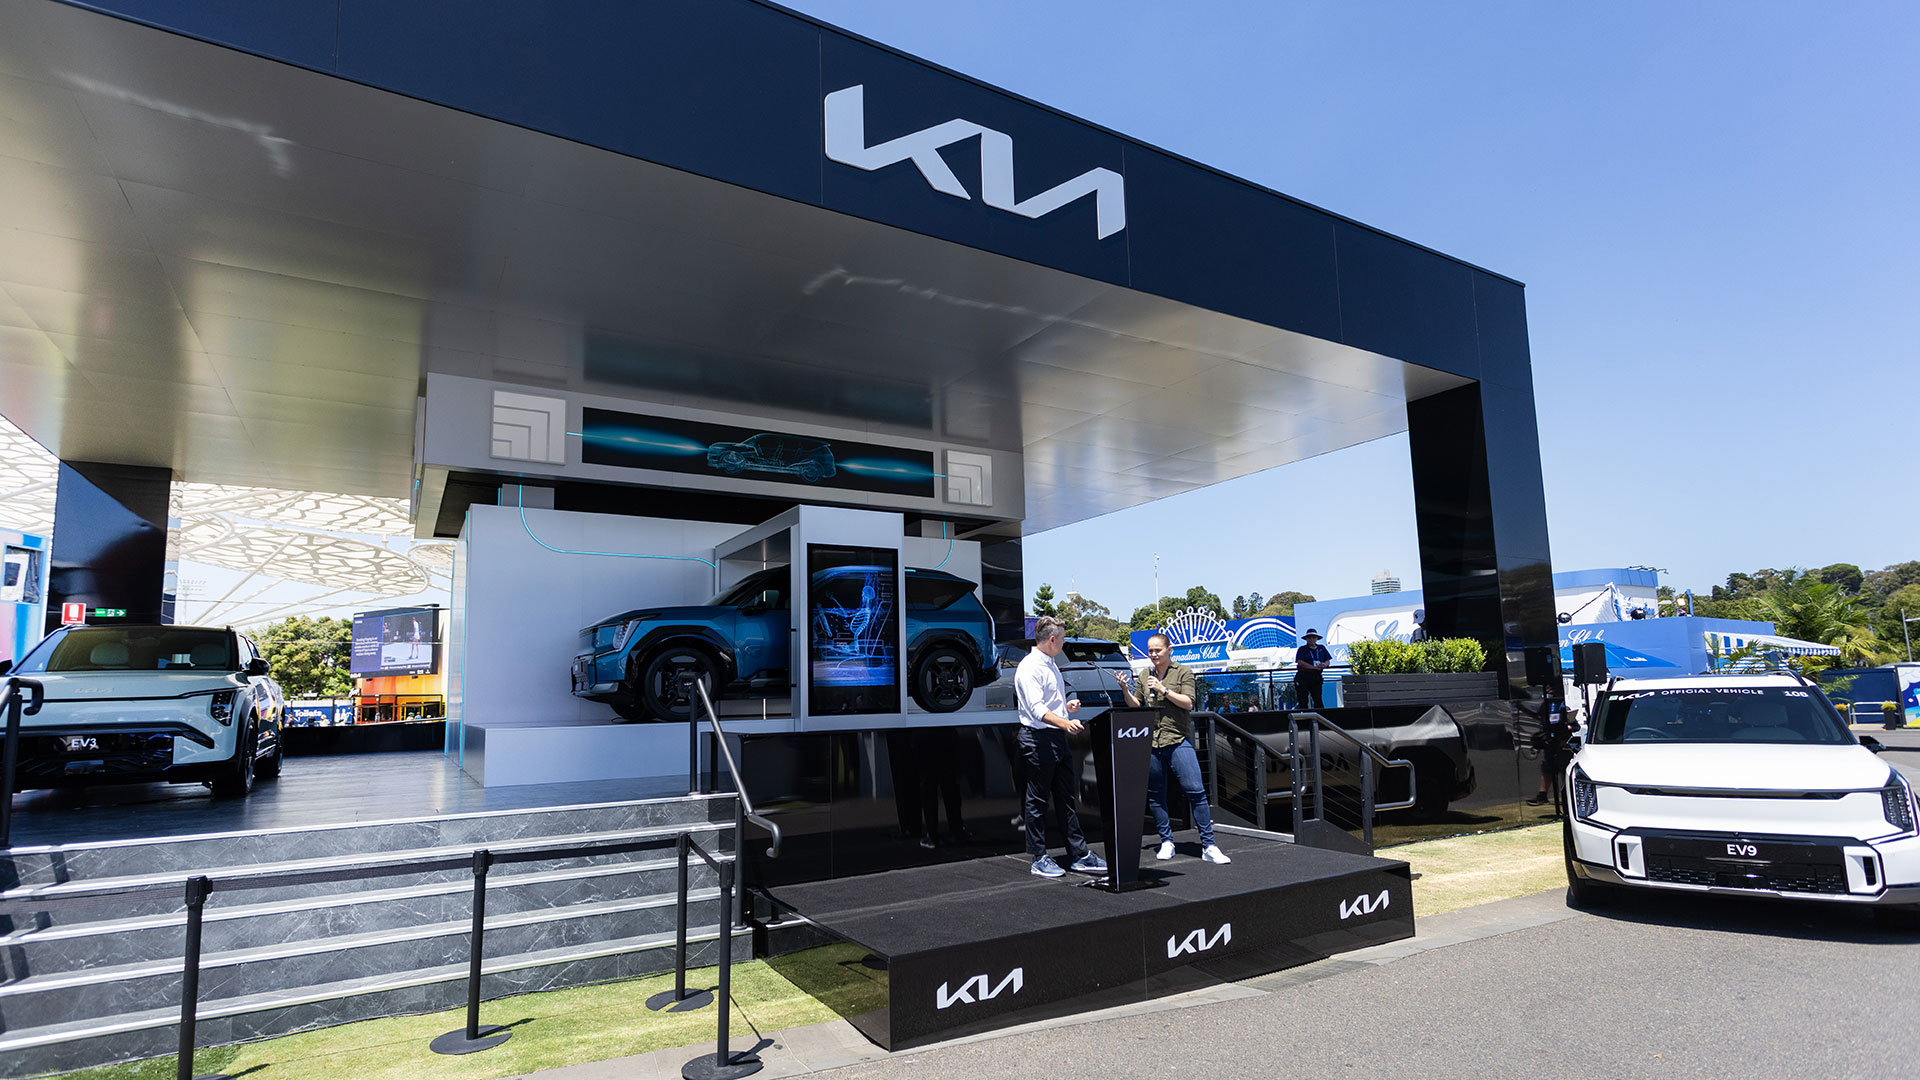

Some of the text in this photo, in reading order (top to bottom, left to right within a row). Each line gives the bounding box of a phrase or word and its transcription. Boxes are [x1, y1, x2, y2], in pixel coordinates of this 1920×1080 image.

[824, 83, 1126, 240] KIA
[1200, 645, 1221, 659] Club
[1618, 691, 1655, 701] KIA
[1661, 688, 1711, 696] OFFICIAL
[293, 709, 323, 717] Toilets
[1117, 726, 1149, 738] KIA
[71, 737, 97, 748] EV3
[1726, 843, 1758, 857] EV9
[1339, 889, 1390, 920] KIA
[1167, 922, 1232, 959] KIA
[936, 967, 1024, 1010] KIA
